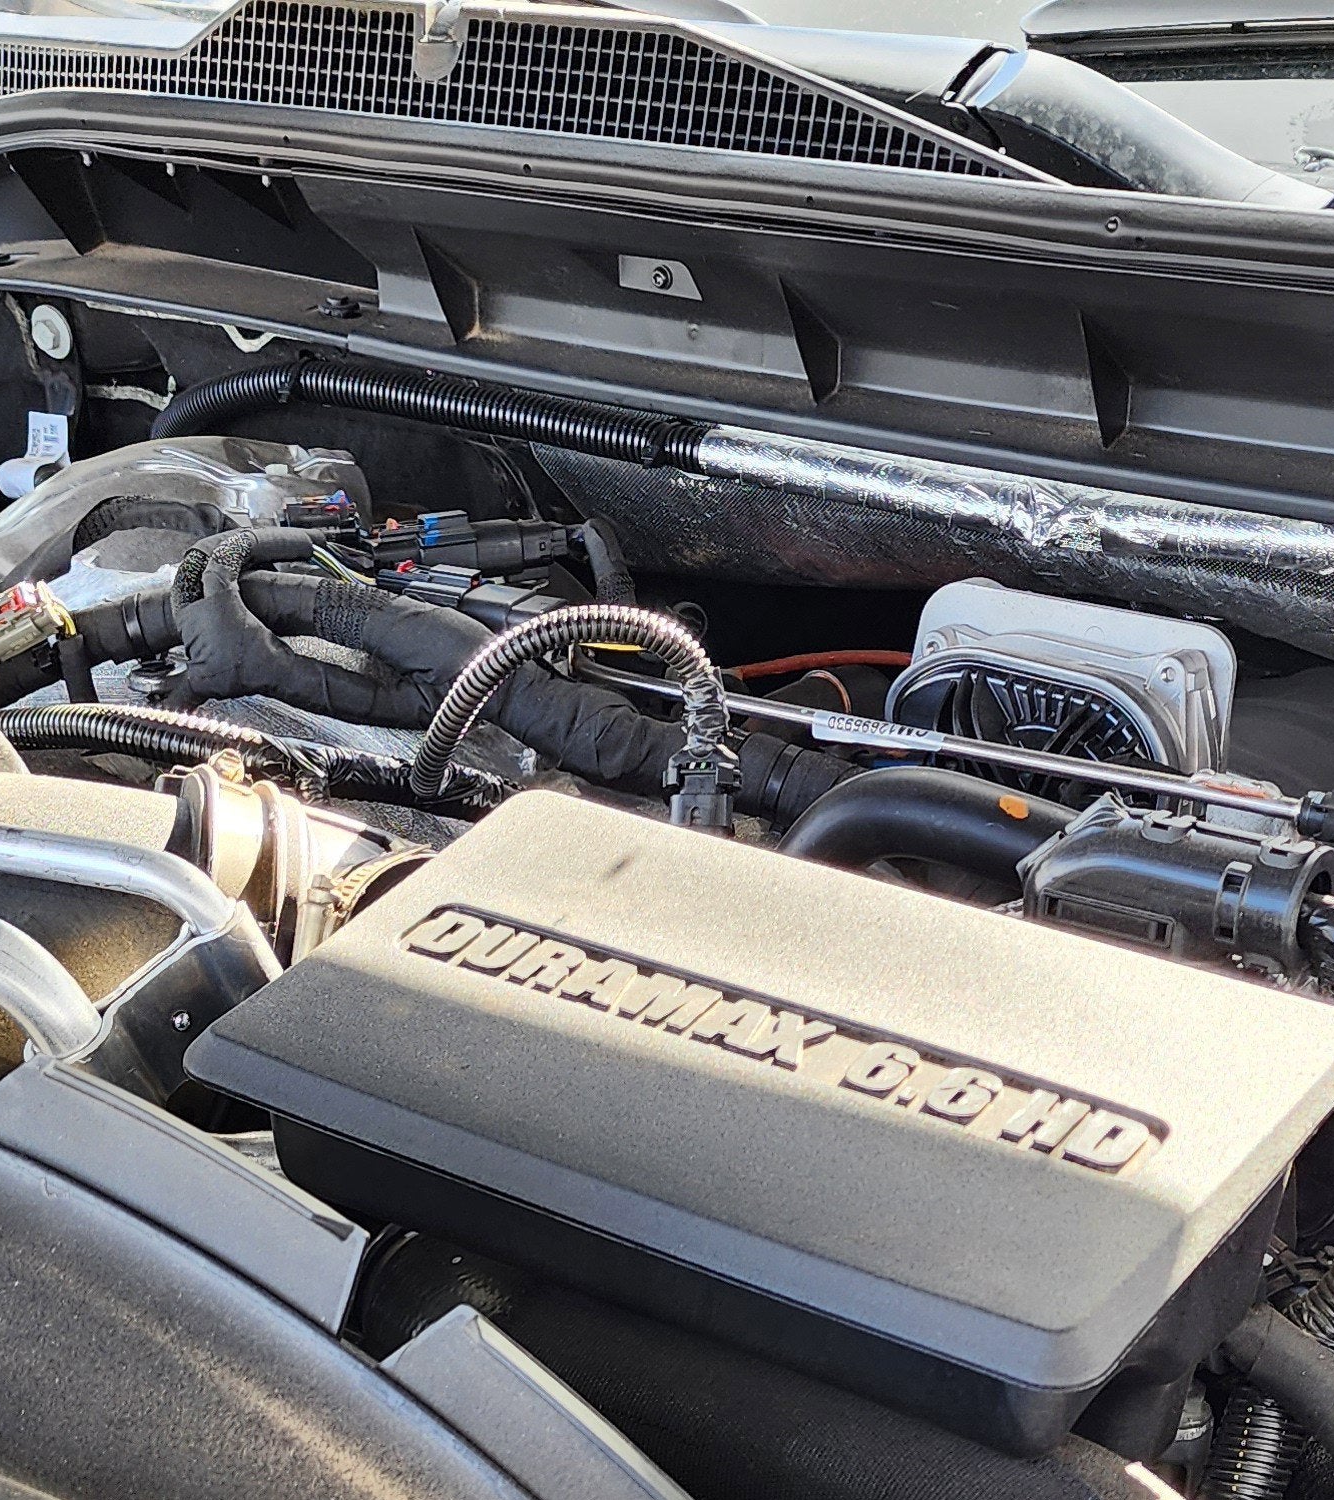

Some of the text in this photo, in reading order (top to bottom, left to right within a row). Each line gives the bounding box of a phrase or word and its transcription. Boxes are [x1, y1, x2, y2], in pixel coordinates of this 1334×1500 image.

[409, 910, 1153, 1174] DURAMAX 6.6 HD
